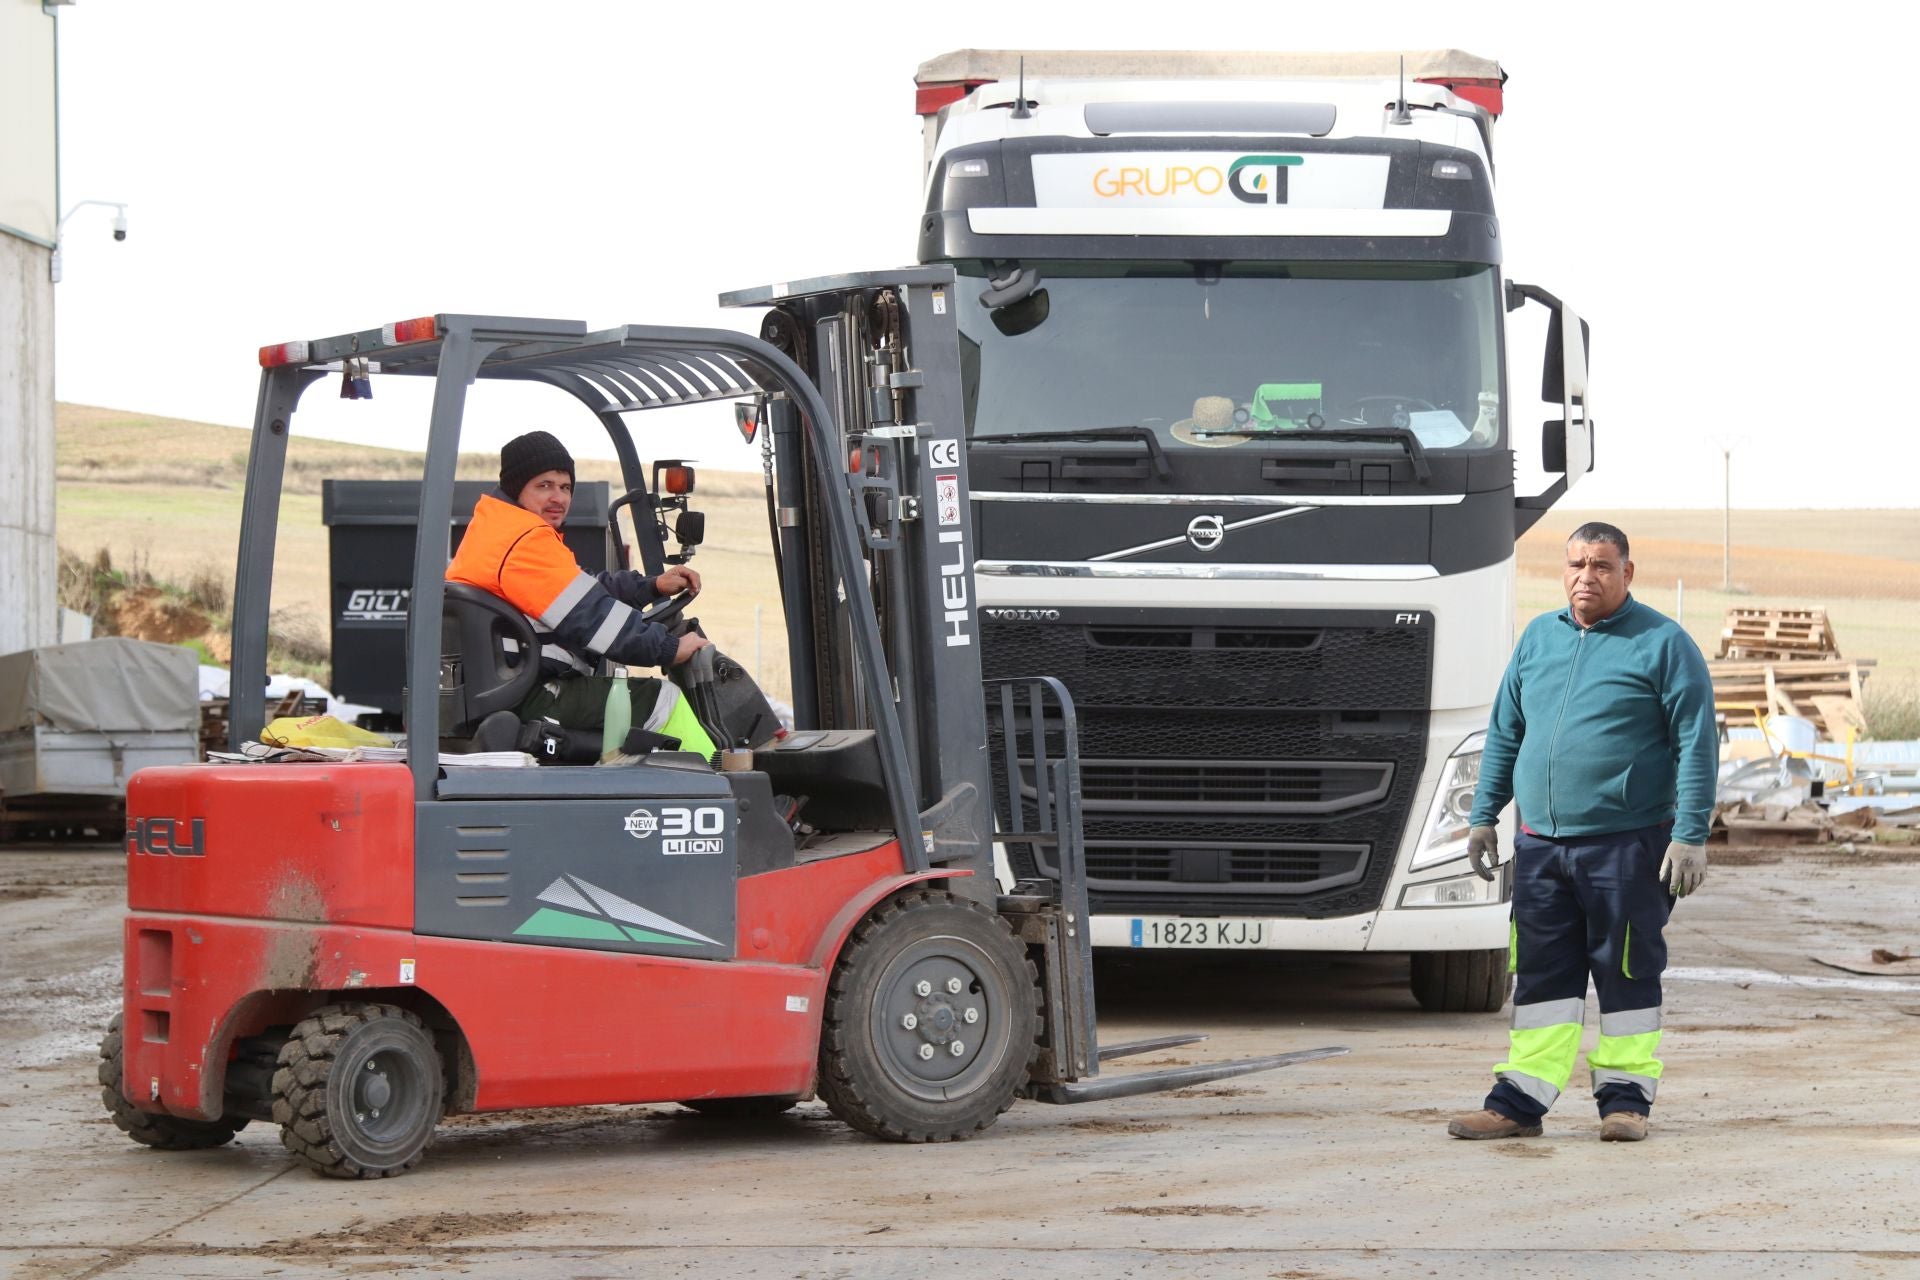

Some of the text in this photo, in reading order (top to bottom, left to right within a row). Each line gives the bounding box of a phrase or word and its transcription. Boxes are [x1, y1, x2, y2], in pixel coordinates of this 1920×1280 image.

[1093, 166, 1223, 197] GRUPO
[931, 442, 957, 465] CE
[938, 531, 971, 647] HELI
[985, 608, 1060, 621] VOLVO
[1395, 613, 1420, 625] FH
[630, 819, 653, 829] NEW
[661, 807, 724, 836] 30
[1152, 922, 1262, 945] 1823 KJJ
